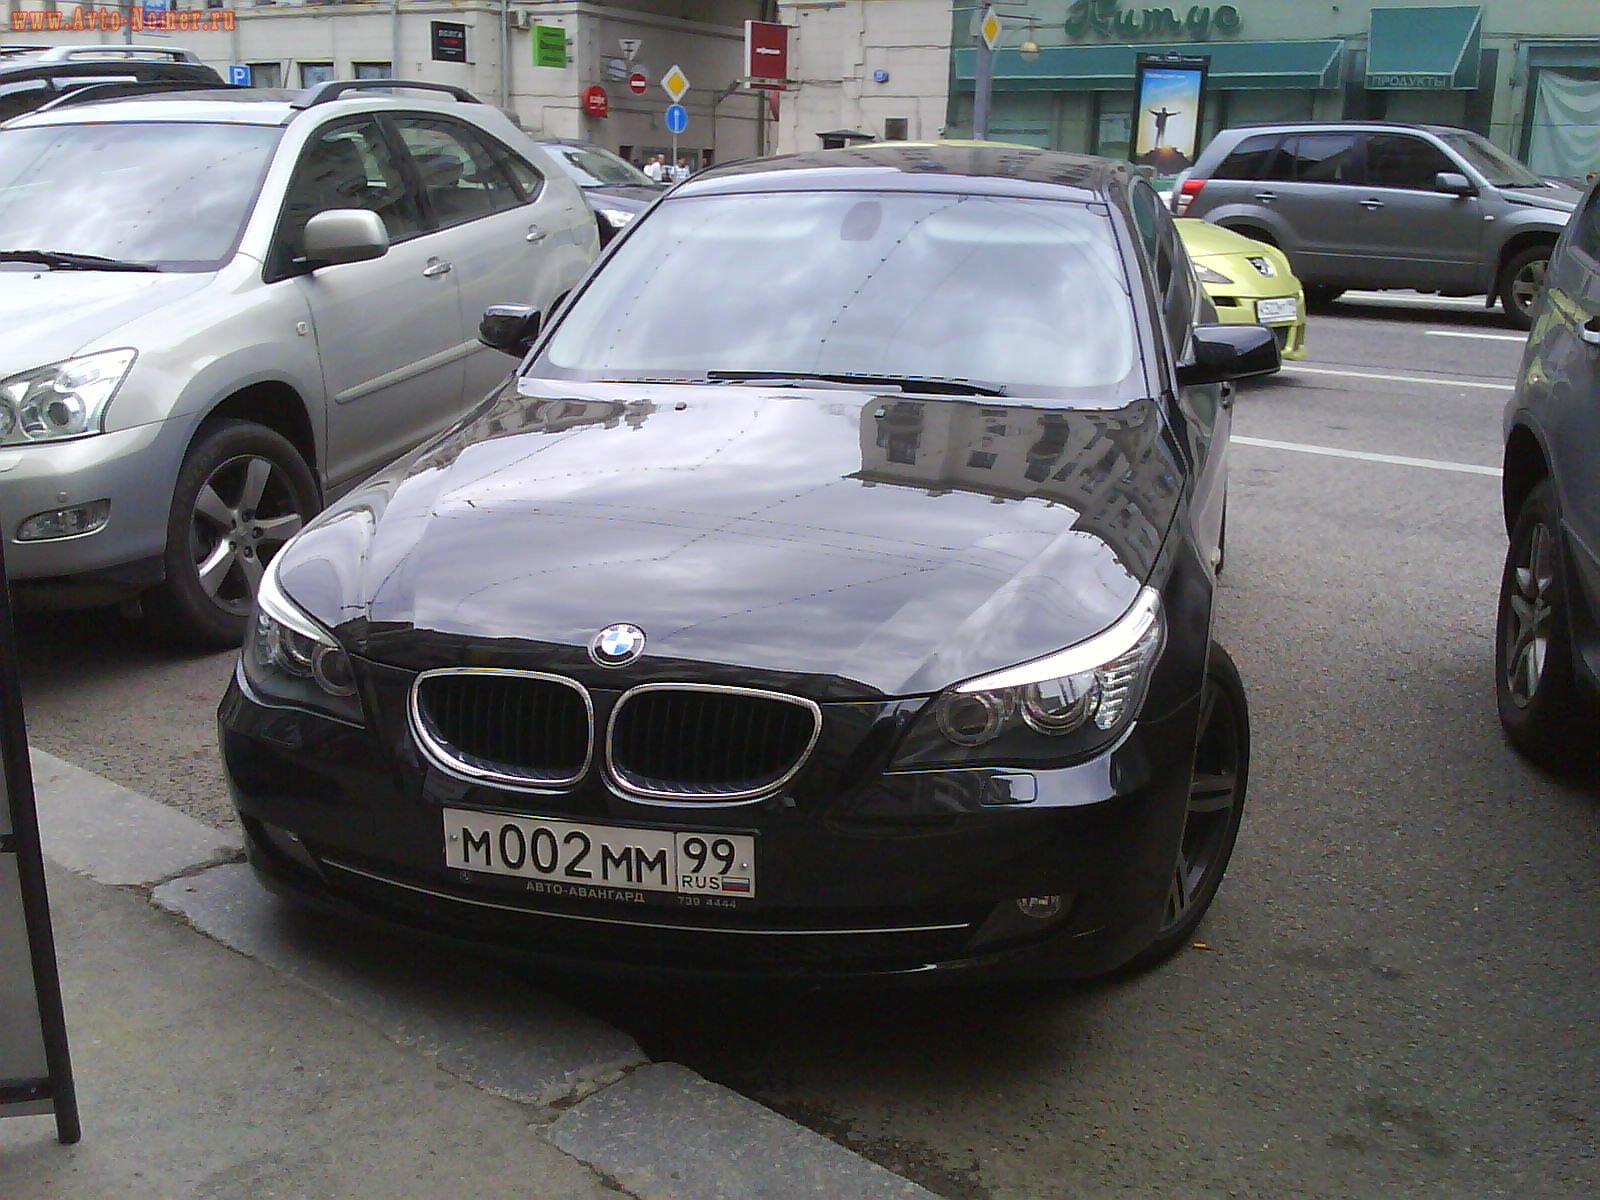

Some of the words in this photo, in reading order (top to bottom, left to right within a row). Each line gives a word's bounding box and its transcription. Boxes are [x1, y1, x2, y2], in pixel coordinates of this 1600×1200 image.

[234, 68, 246, 84] P
[1372, 75, 1446, 87] ПРОДУКТЫ
[681, 874, 720, 890] RUS
[526, 880, 645, 904] АВТО-АВАНГАРД
